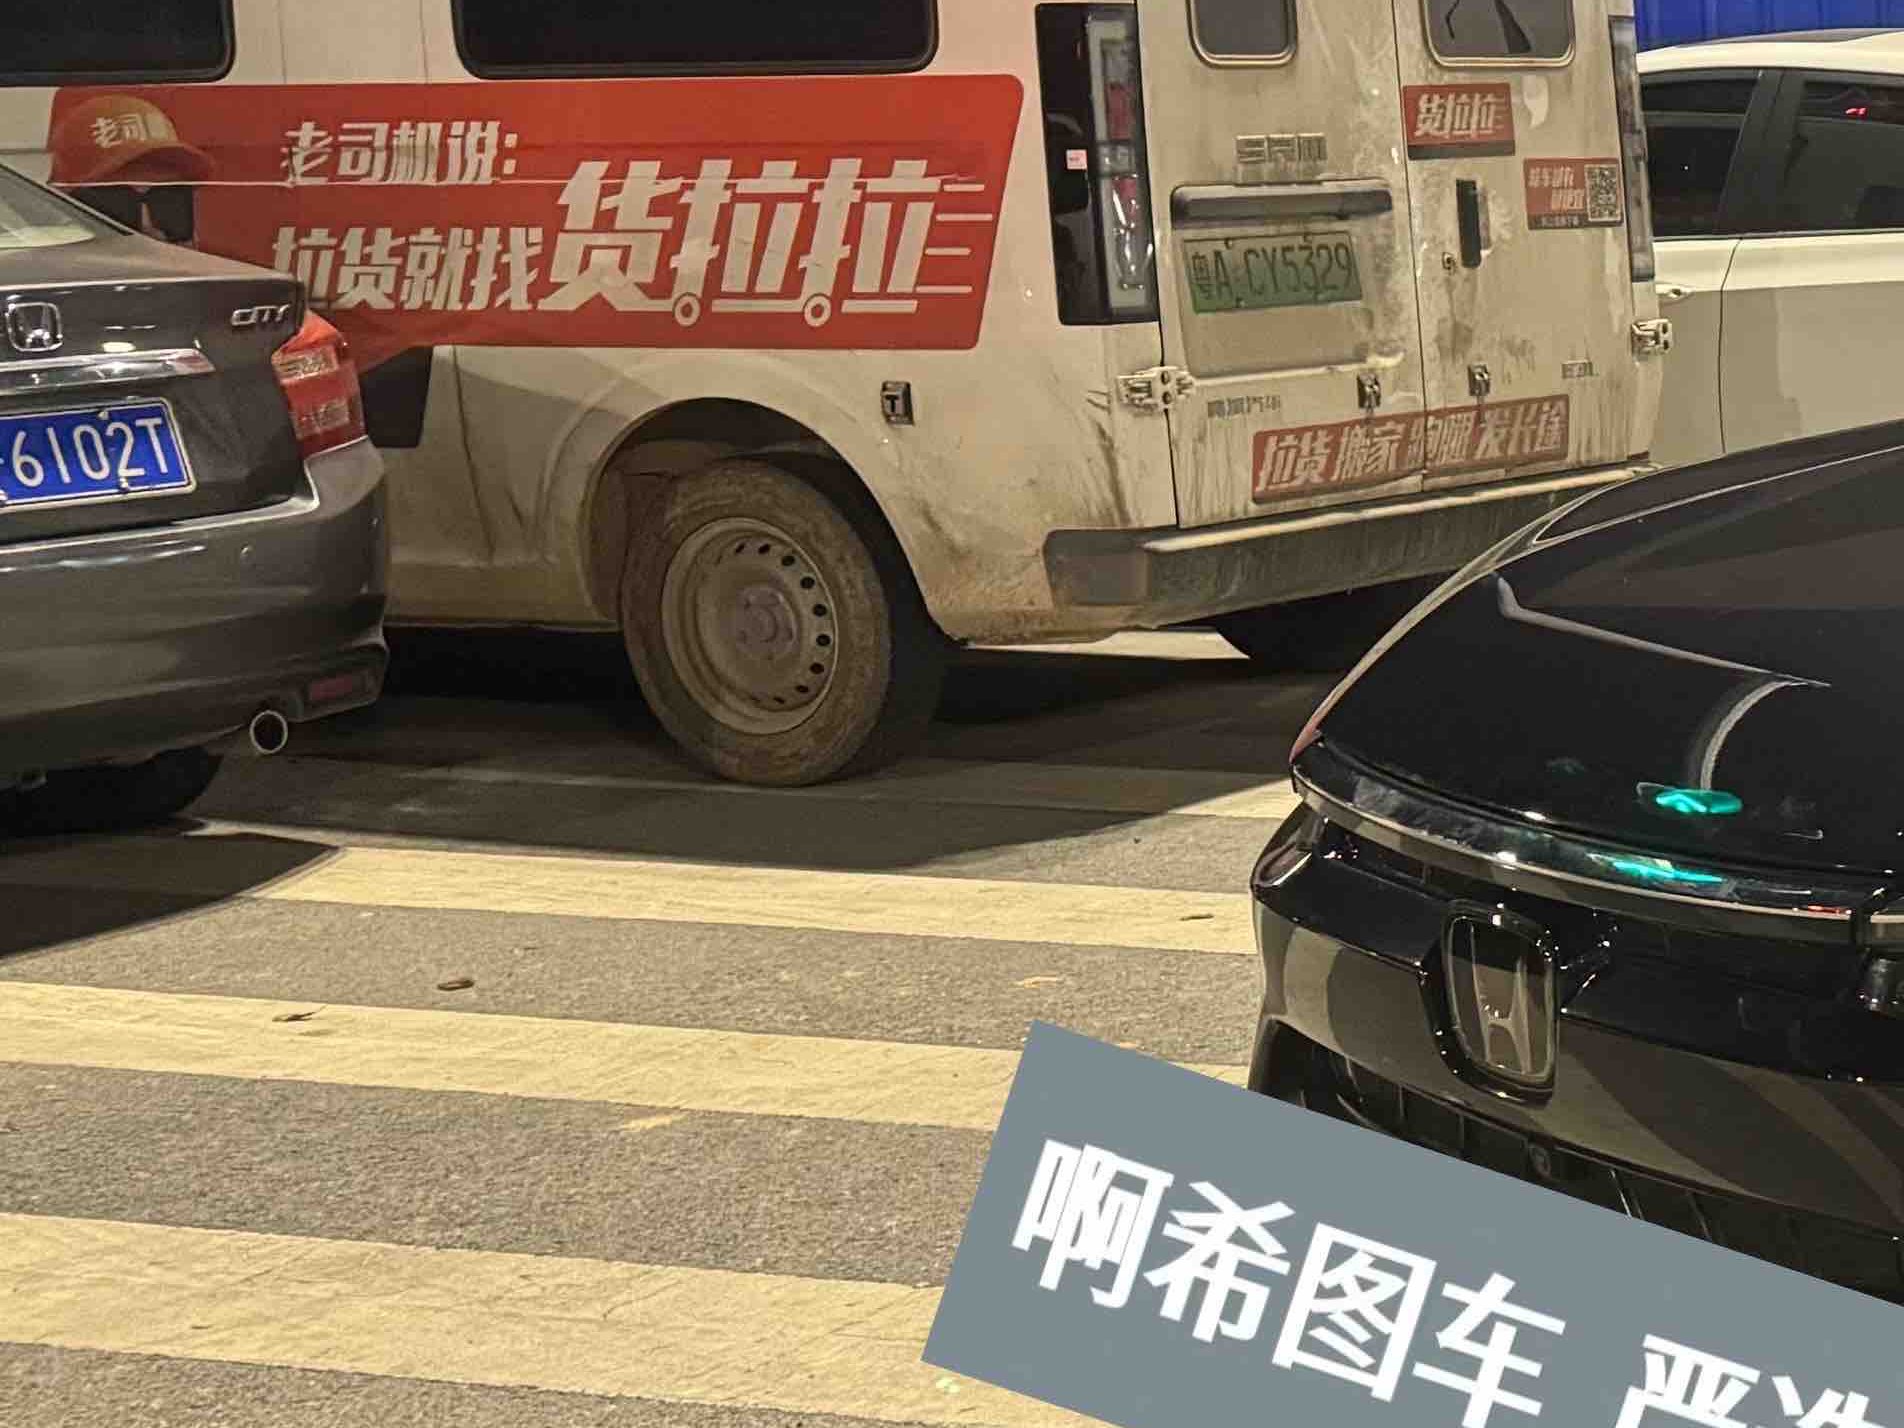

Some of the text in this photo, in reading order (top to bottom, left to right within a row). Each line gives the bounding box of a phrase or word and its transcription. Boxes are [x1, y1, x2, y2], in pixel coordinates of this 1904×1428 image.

[1414, 92, 1497, 139] 货拉拉
[272, 226, 543, 311] 拉货就找
[537, 158, 942, 326] 货拉拉
